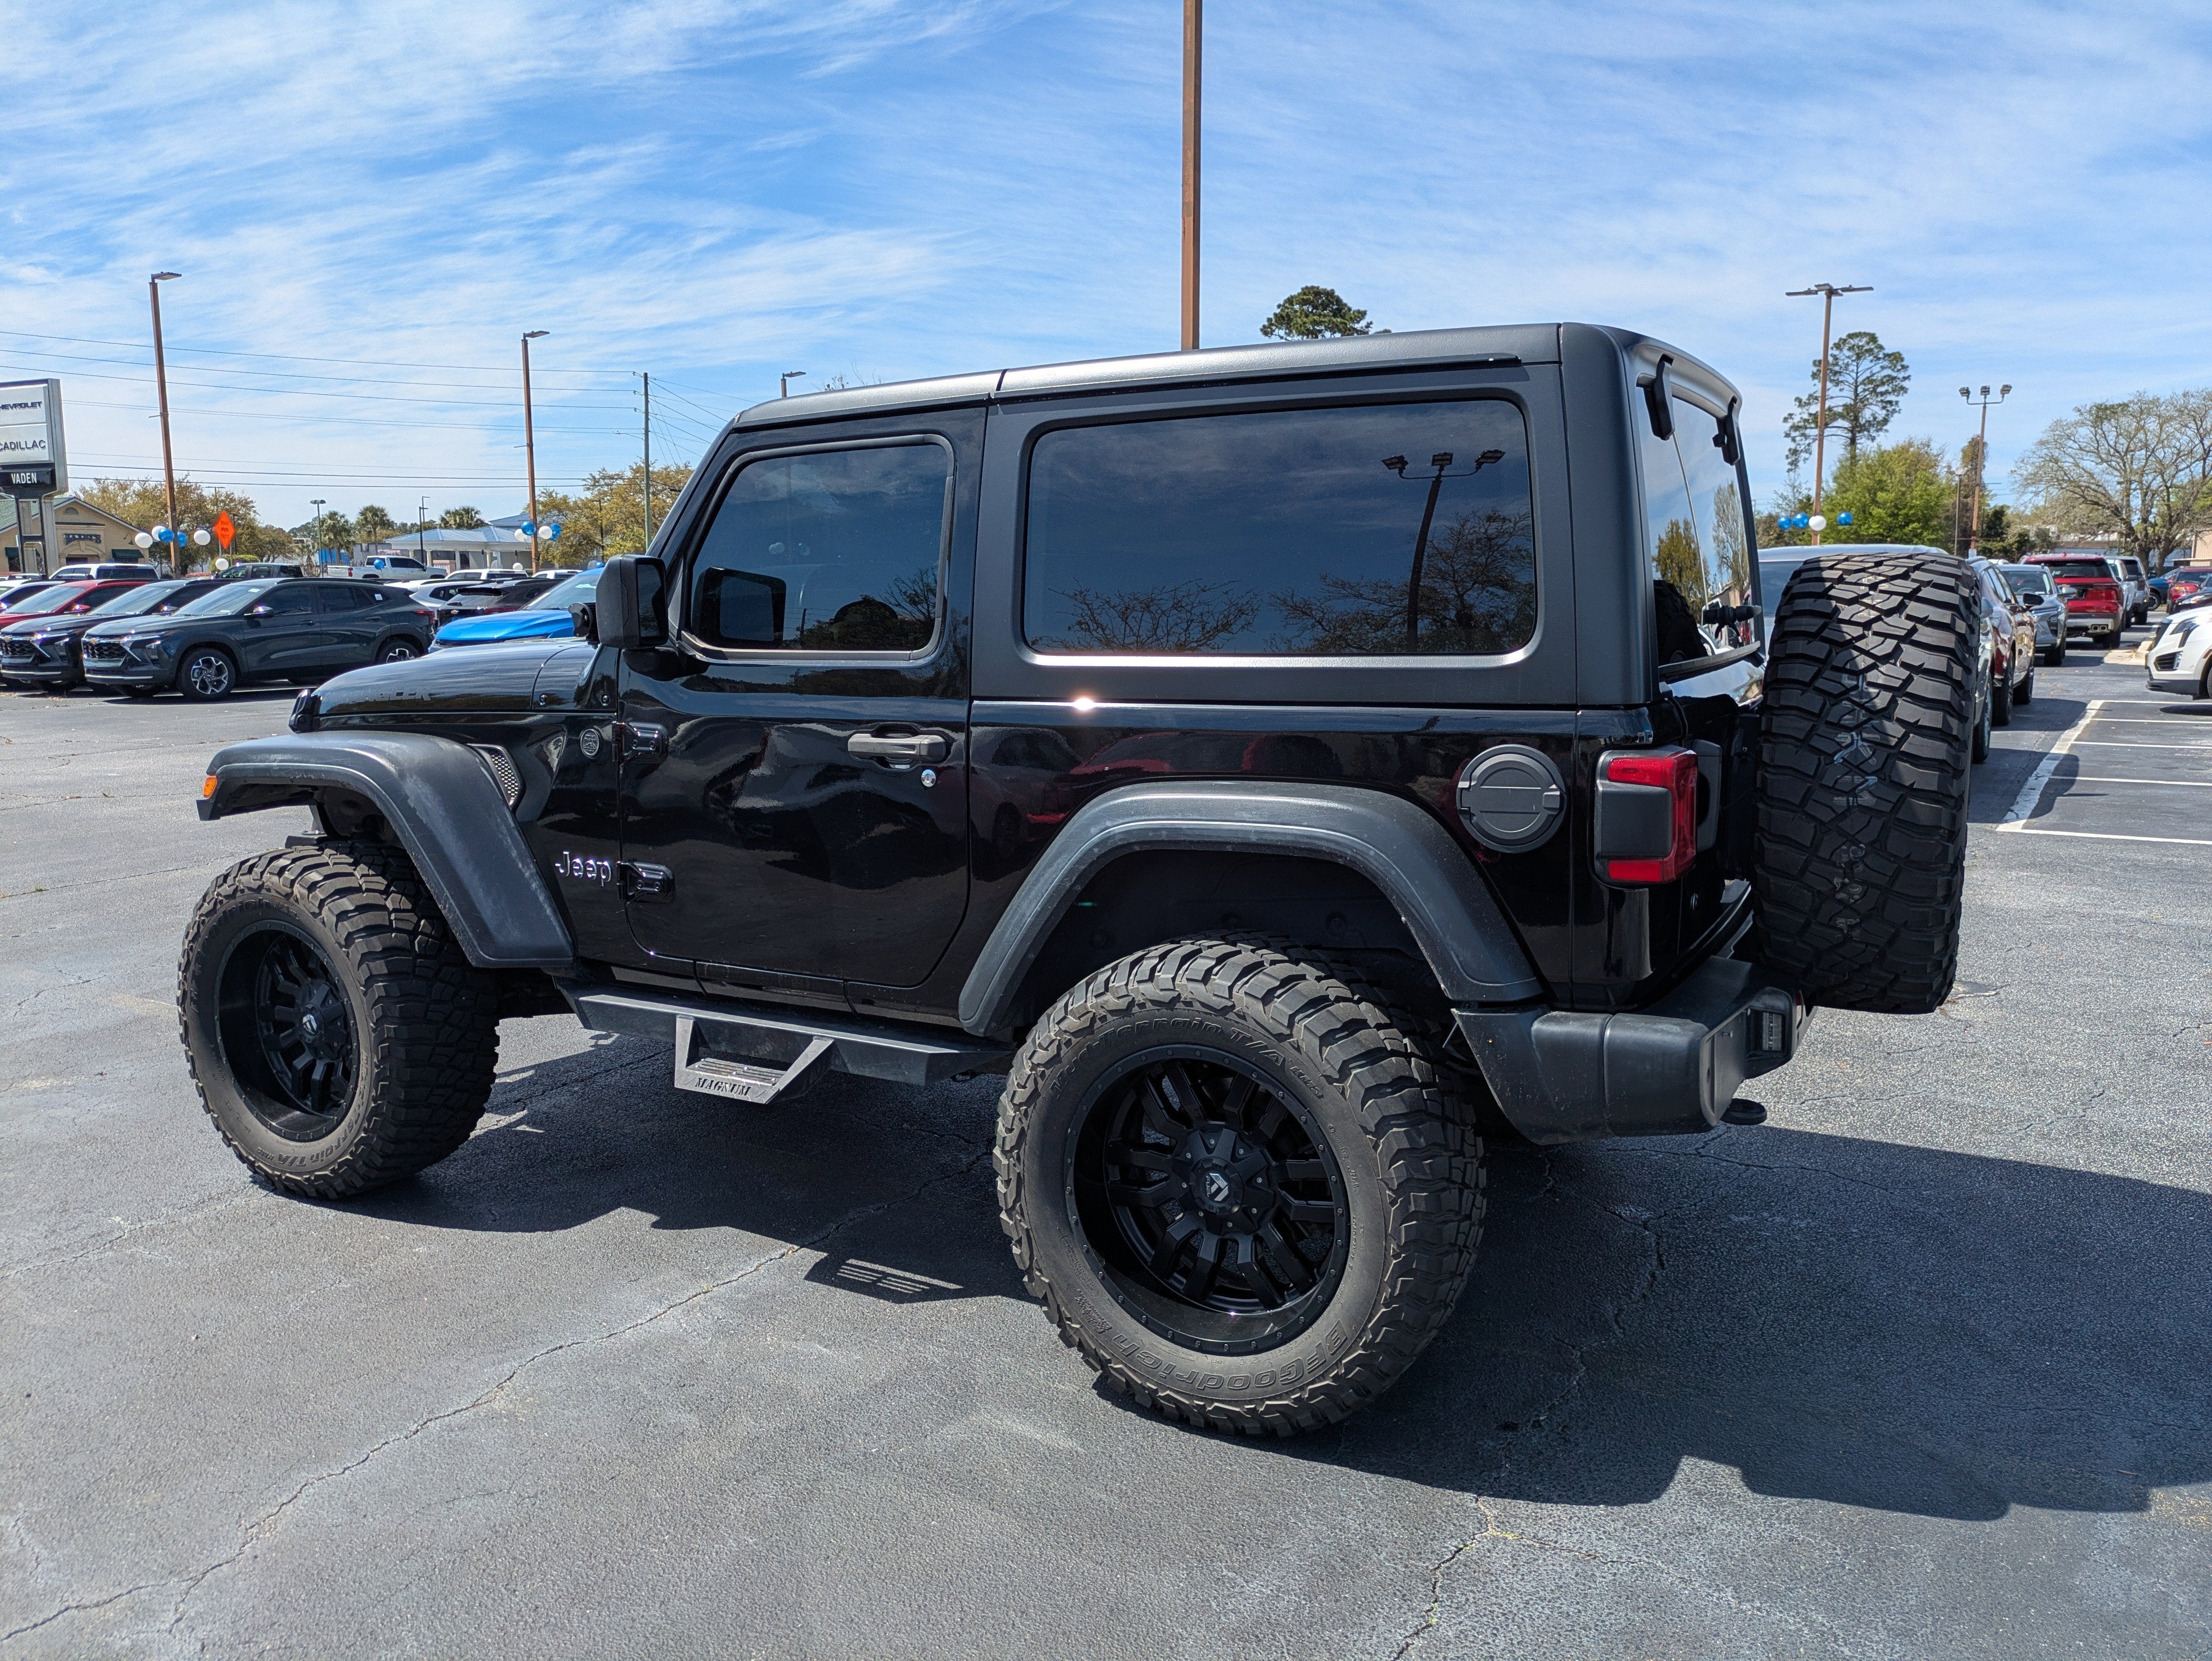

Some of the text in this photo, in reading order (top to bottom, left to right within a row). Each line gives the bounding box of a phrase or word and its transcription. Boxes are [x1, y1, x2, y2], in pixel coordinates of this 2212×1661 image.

[0, 401, 42, 410] HEVROLET
[11, 473, 37, 484] VADEN
[555, 851, 611, 887] Jeep
[695, 1077, 751, 1096] MAGNUM
[1113, 1319, 1348, 1390] BFGoodrich
